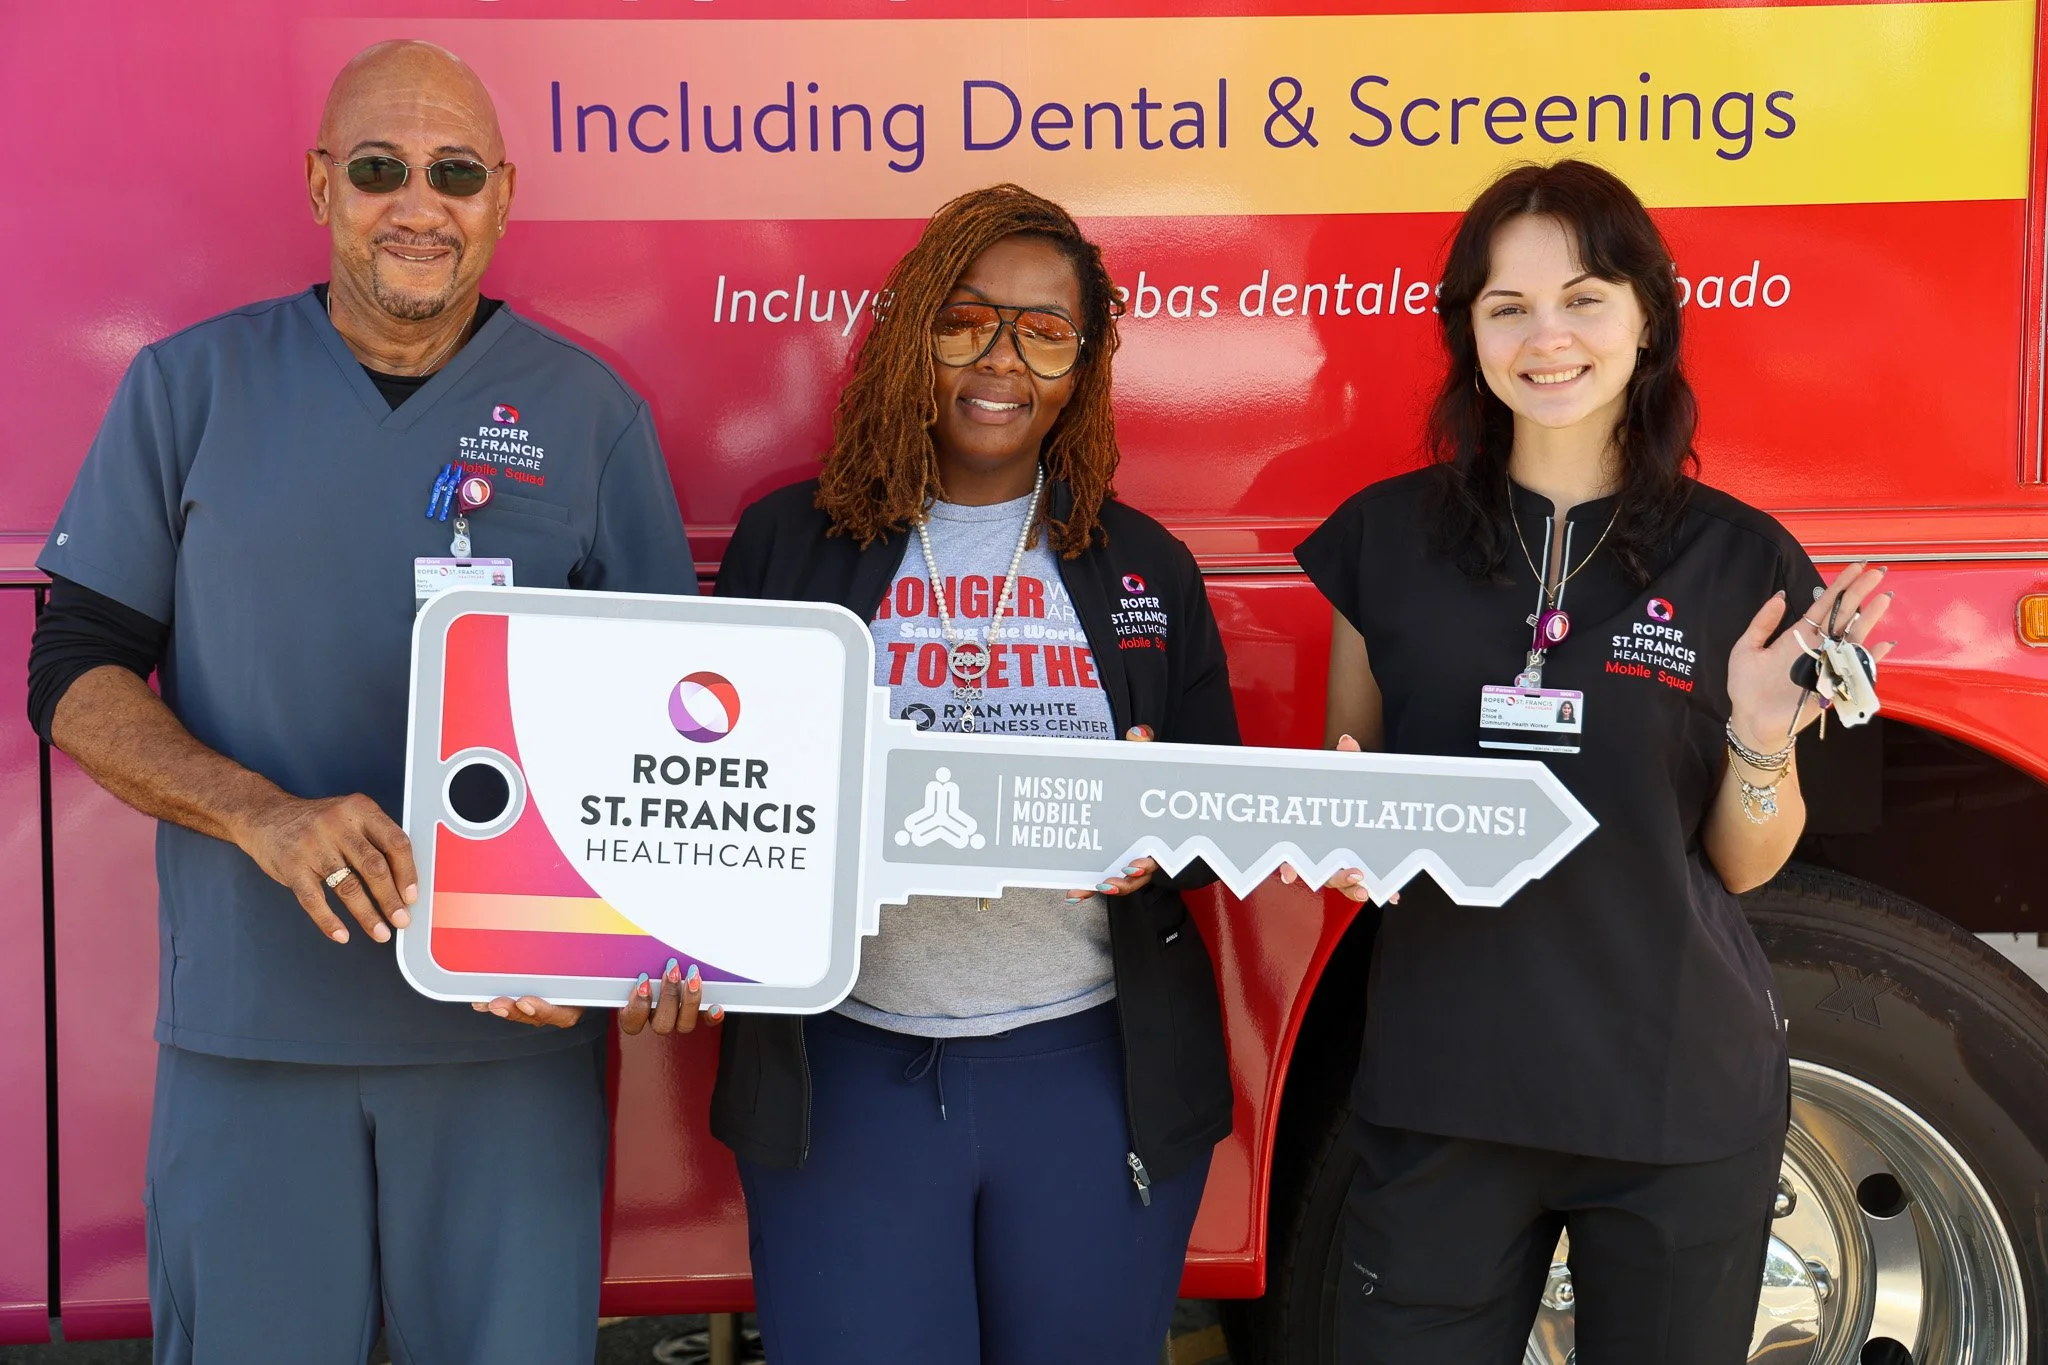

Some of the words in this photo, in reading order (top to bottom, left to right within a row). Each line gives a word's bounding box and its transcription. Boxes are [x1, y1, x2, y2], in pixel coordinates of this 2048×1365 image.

[551, 81, 925, 172] Including
[963, 79, 1228, 152] Dental
[1263, 76, 1318, 148] &
[1350, 73, 1796, 160] Screenings
[479, 427, 529, 441] ROPER
[460, 449, 541, 470] HEALTHCARE
[505, 467, 545, 487] Squad
[1047, 603, 1081, 625] AR
[1120, 597, 1160, 610] ROPER
[1632, 622, 1683, 643] ROPER
[888, 642, 1101, 689] TOETHE
[1613, 649, 1692, 676] HEALTHCARE
[1605, 660, 1652, 679] Mobile
[1657, 670, 1694, 693] Squad
[1009, 703, 1077, 717] WHITE
[1525, 699, 1553, 707] FRANCIS
[942, 719, 1039, 734] WLLNESS
[1046, 719, 1108, 733] CENTER
[1482, 719, 1511, 727] Community
[633, 753, 769, 789] ROPER
[1013, 776, 1104, 801] MISSION
[1012, 800, 1092, 826] MOBILE
[1138, 788, 1528, 837] CONGRATULATIONS!
[1011, 823, 1103, 852] MEDICAL
[586, 838, 807, 870] HEALTHCARE
